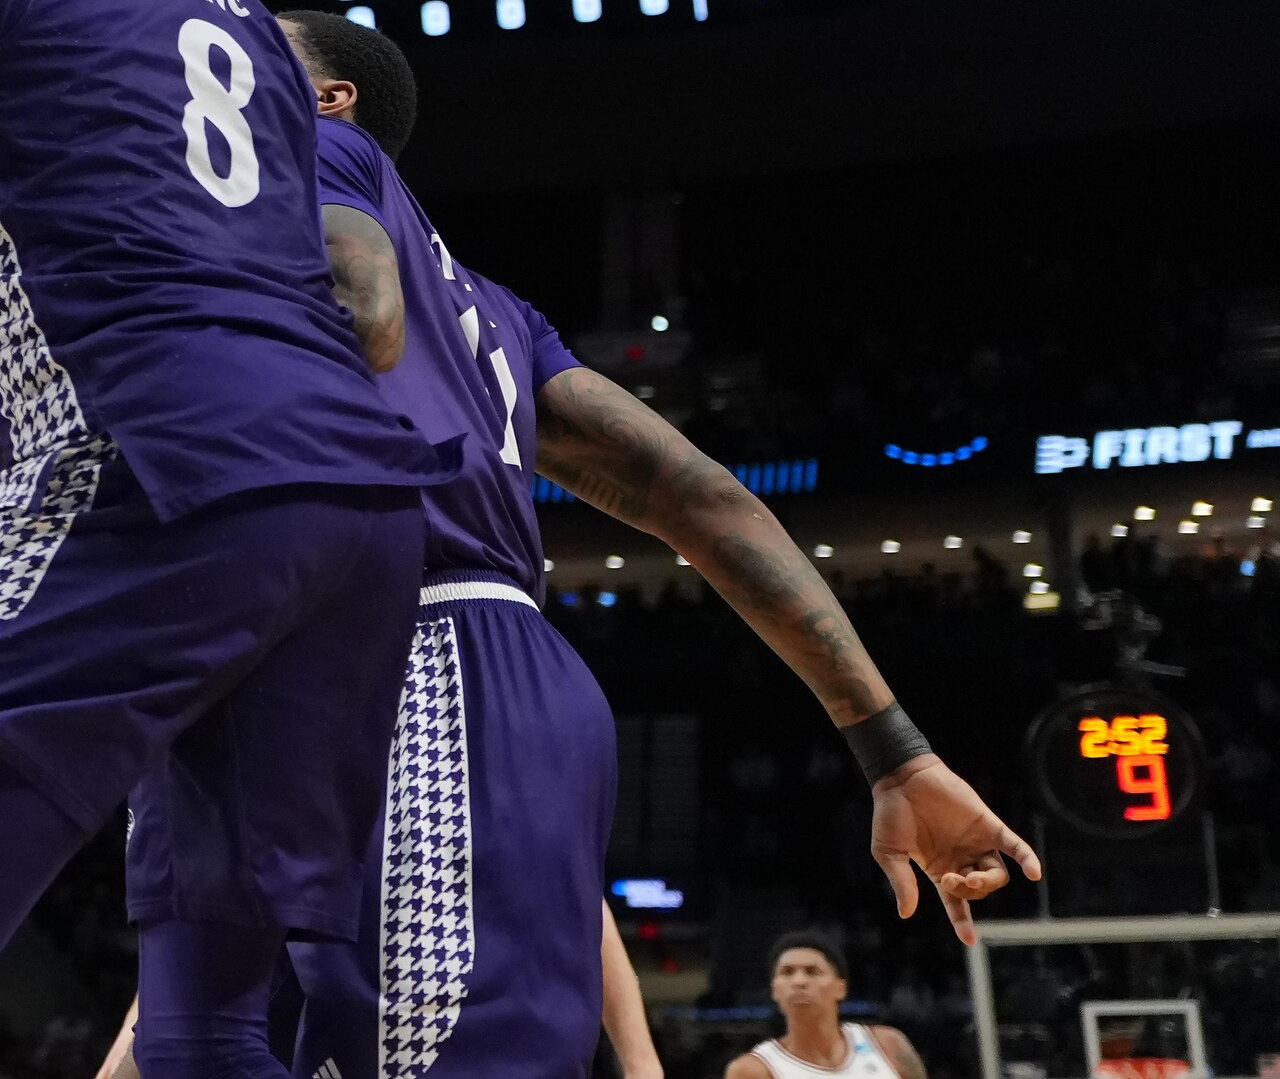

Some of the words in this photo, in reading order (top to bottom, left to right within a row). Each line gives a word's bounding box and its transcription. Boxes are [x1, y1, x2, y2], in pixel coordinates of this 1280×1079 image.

[421, 0, 450, 36] 0
[178, 18, 260, 208] 8
[1092, 420, 1243, 469] FIRST
[1116, 754, 1172, 821] 9
